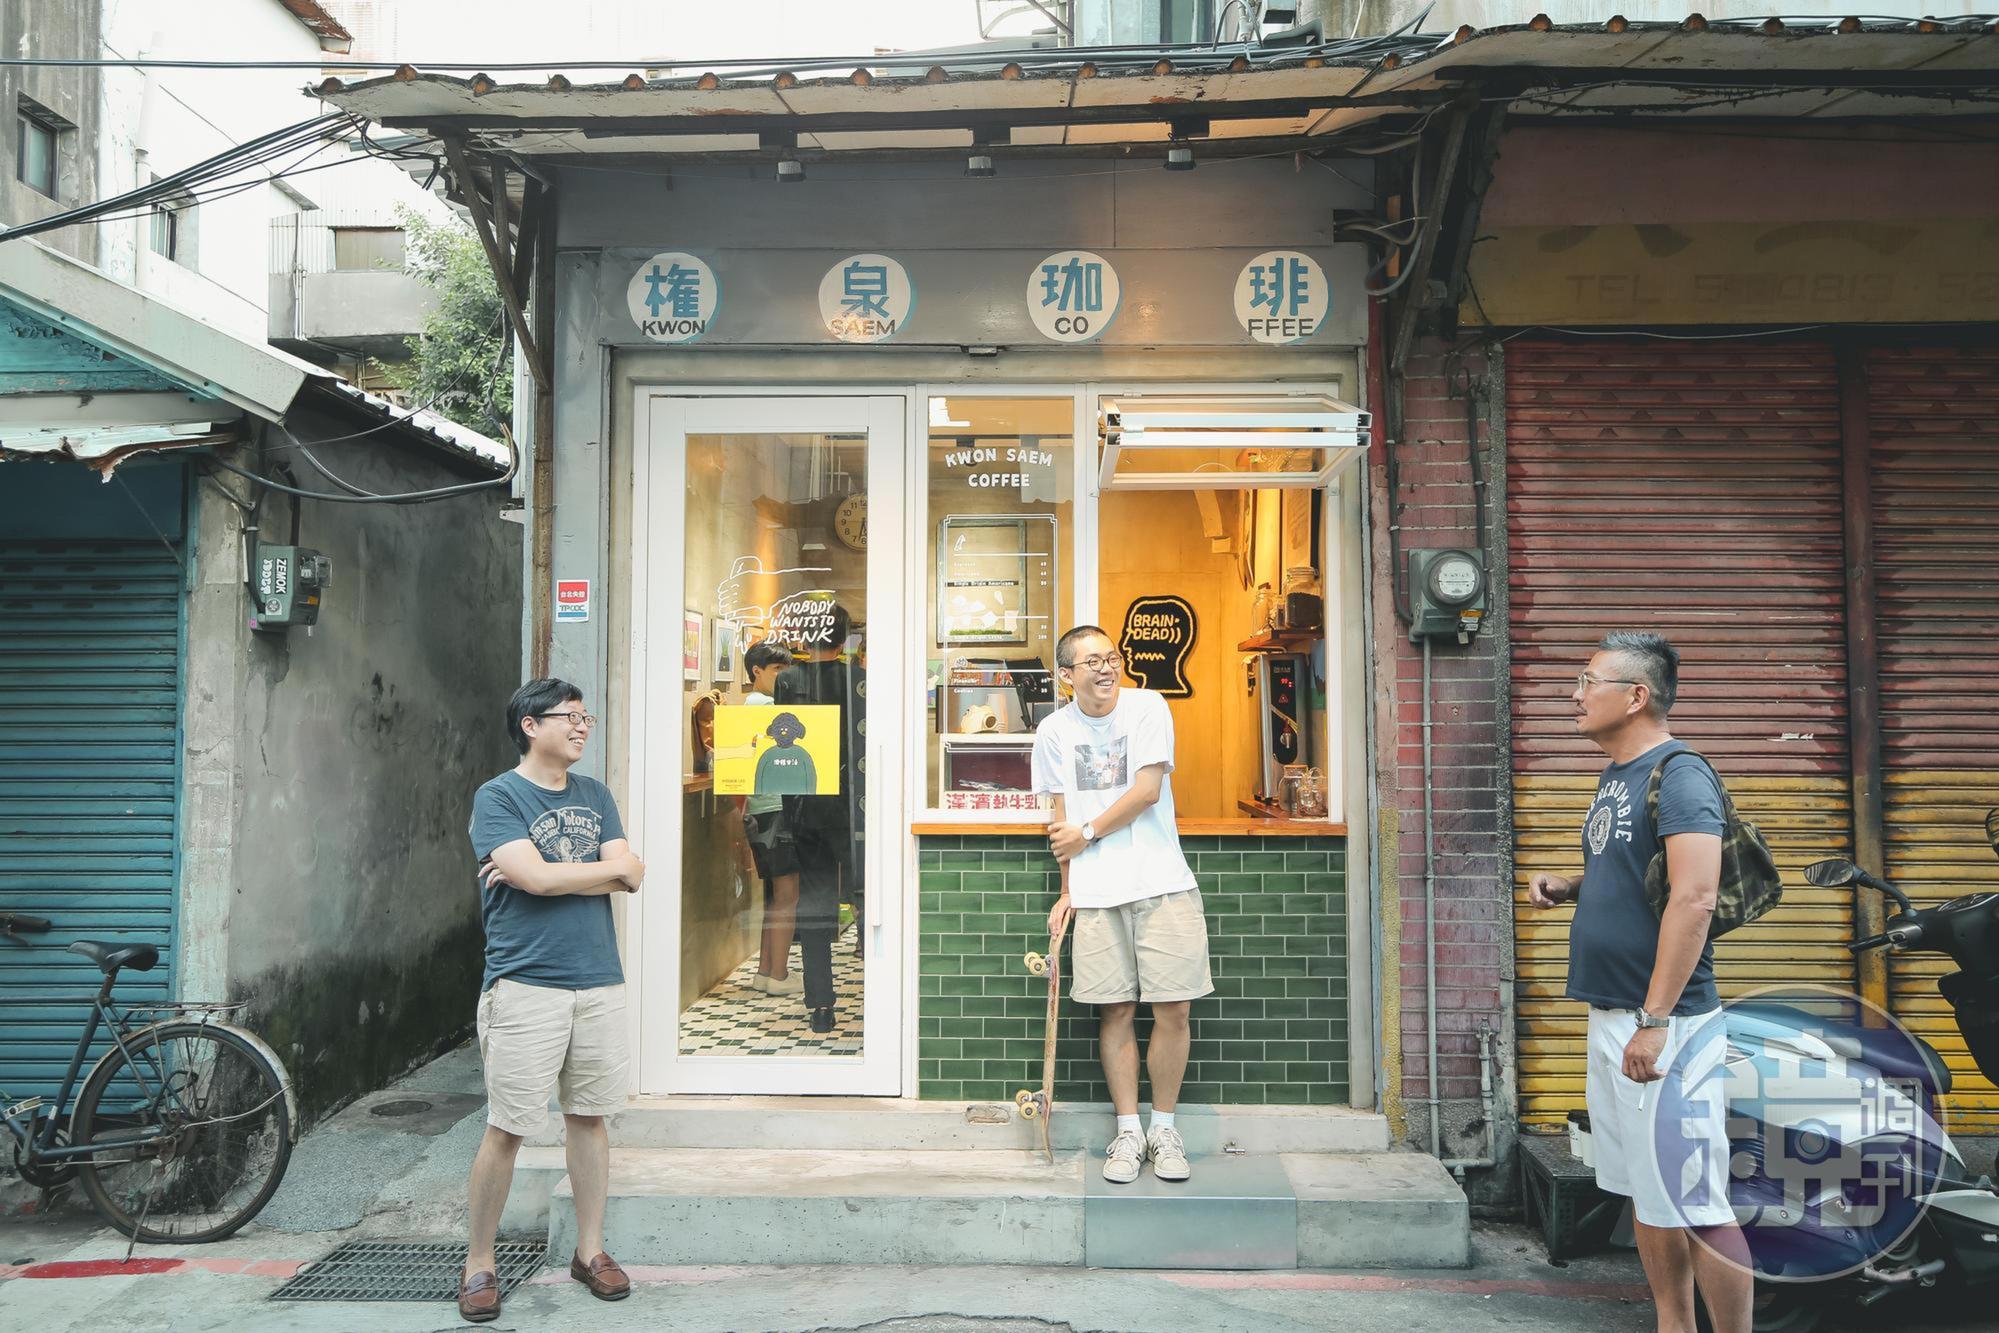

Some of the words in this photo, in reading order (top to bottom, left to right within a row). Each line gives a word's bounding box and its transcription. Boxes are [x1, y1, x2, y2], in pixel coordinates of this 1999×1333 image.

[840, 261, 890, 319] 泉
[1040, 257, 1103, 312] 珈
[1249, 257, 1310, 318] 琲
[641, 319, 706, 336] KWON
[830, 319, 896, 336] SAEM
[1054, 315, 1090, 335] CO
[1247, 318, 1314, 337] FFEE
[944, 447, 997, 468] KWON
[1006, 448, 1054, 467] SAEM
[968, 473, 1031, 488] COFFEE
[275, 557, 288, 595] ZEMOK
[777, 599, 836, 618] NOBODY
[769, 615, 818, 628] WANTS
[820, 614, 836, 628] TO
[763, 627, 834, 645] DRINK
